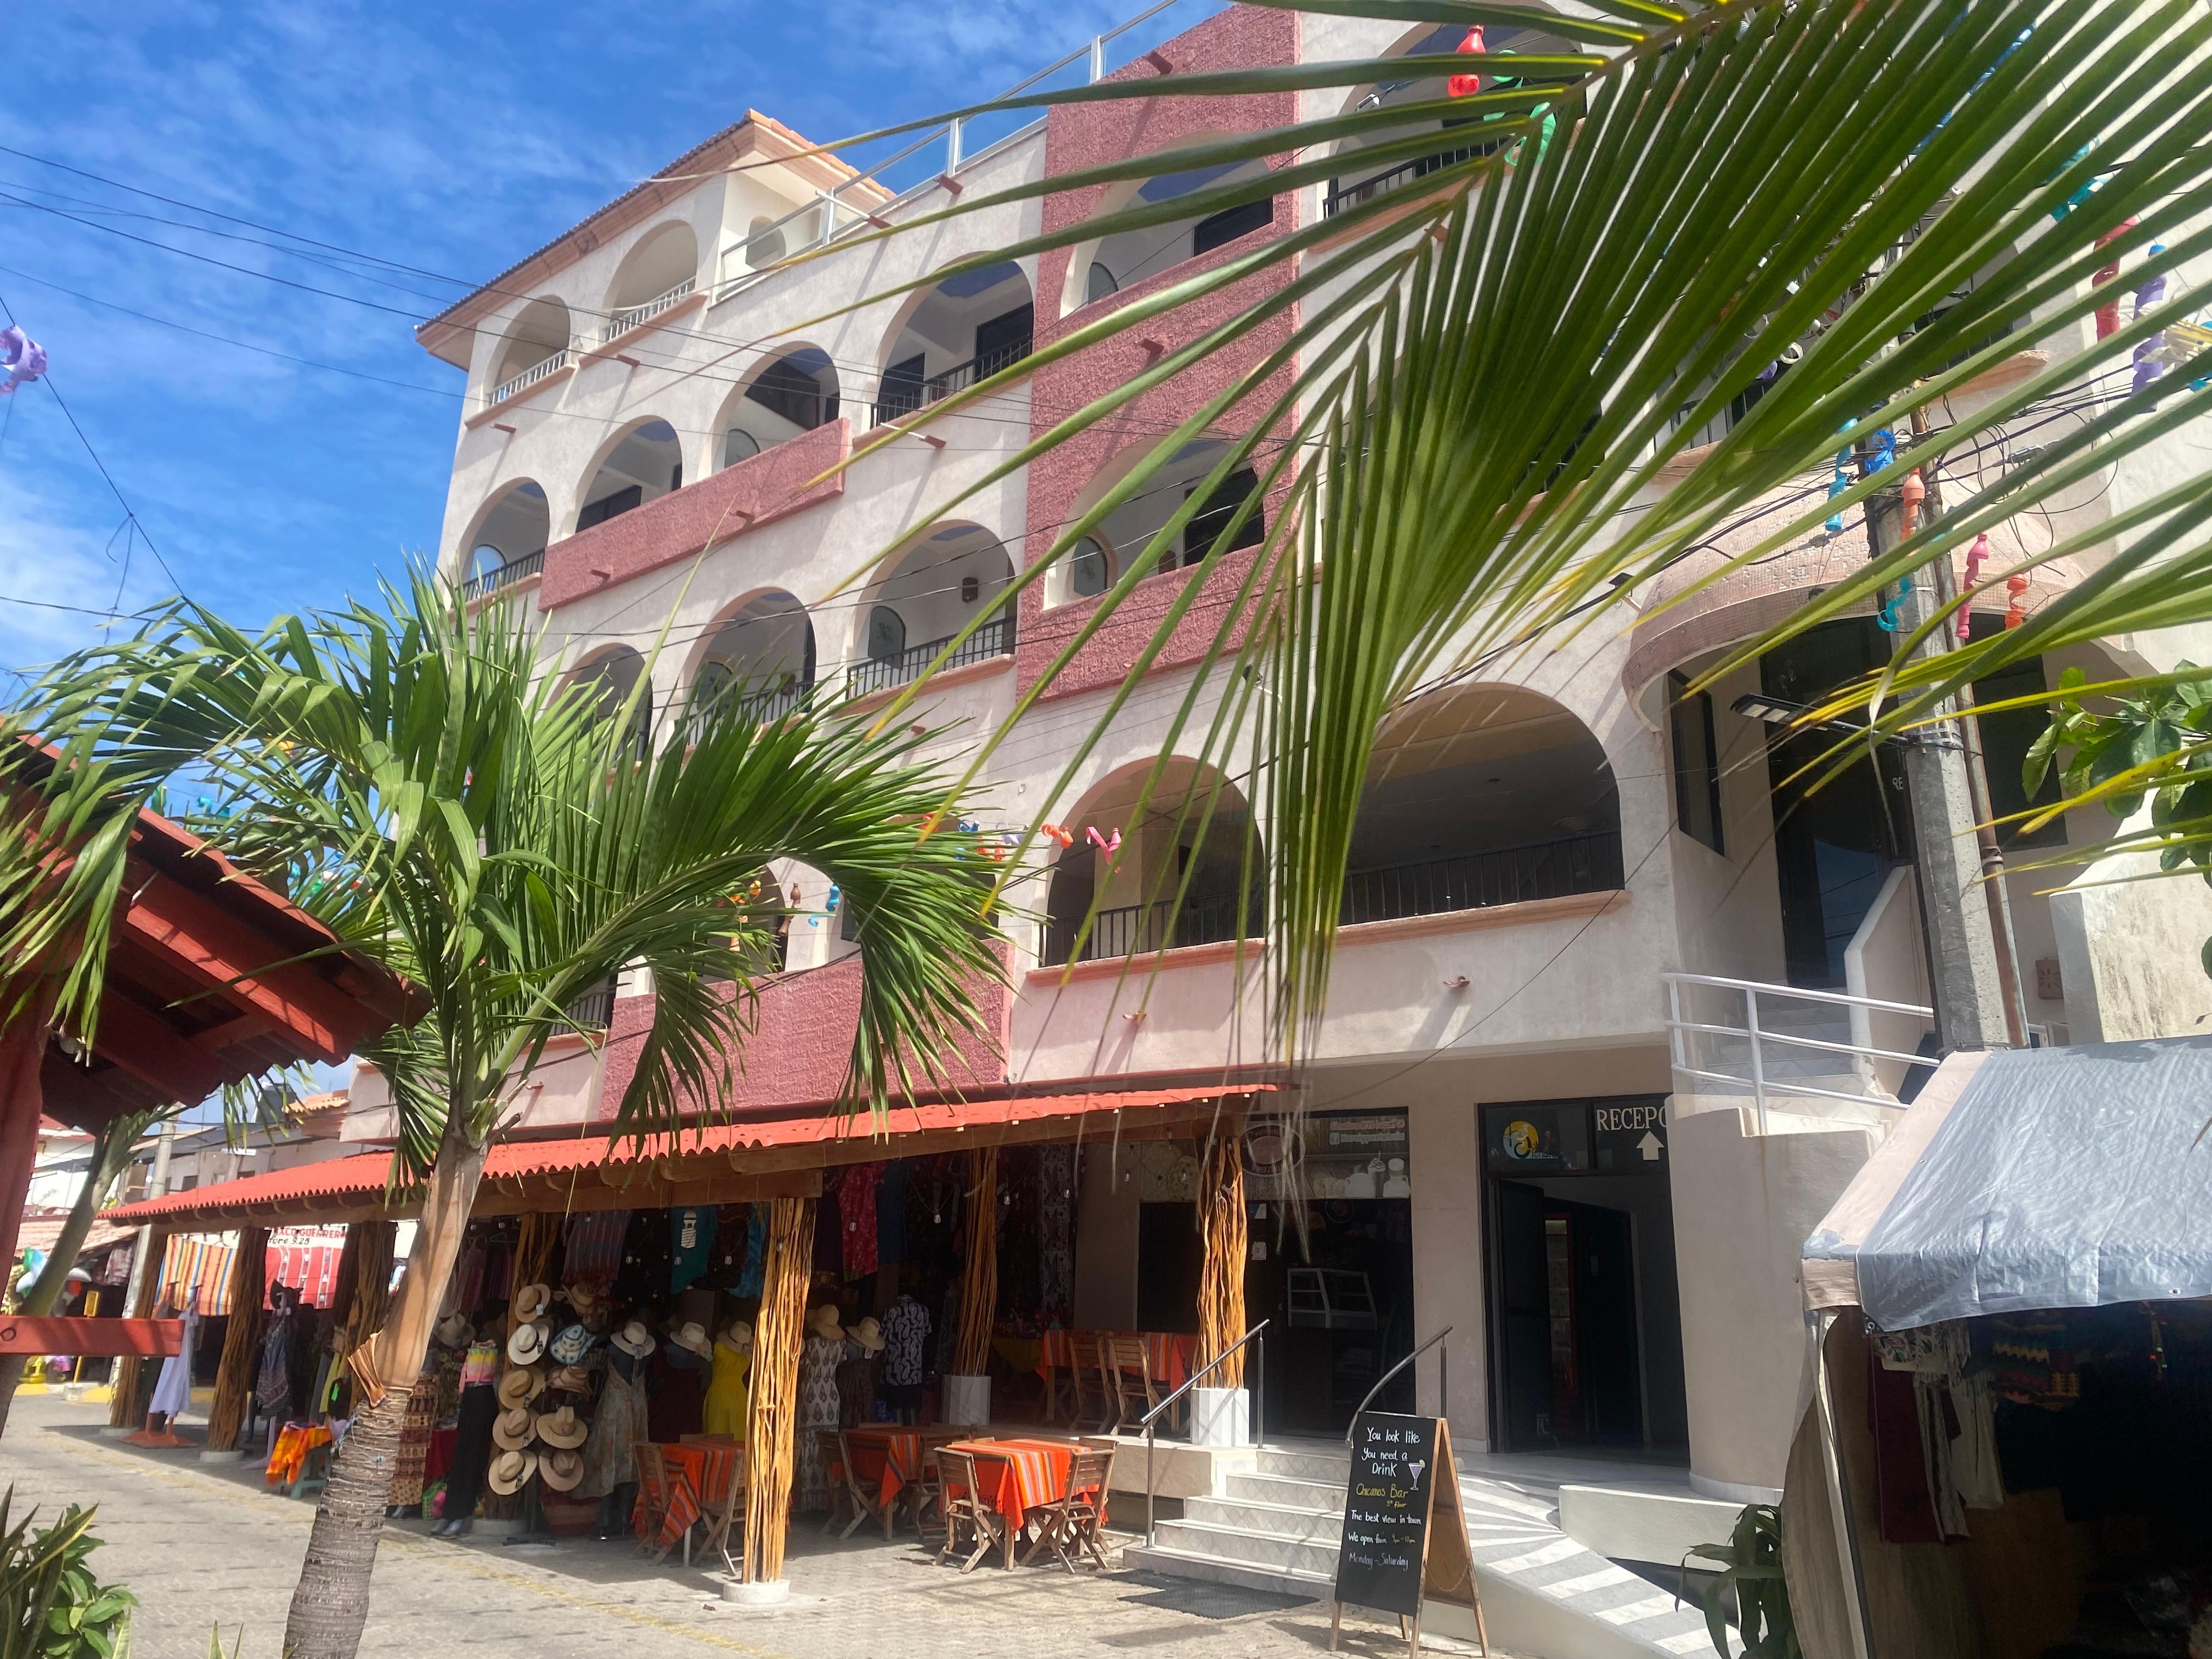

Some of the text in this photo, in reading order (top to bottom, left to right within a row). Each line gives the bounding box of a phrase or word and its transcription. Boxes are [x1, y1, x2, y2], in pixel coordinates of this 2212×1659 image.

[1367, 1426, 1420, 1444] You look like
[1380, 1449, 1398, 1460] need
[1401, 1452, 1408, 1461] a
[1356, 1483, 1409, 1498] Chicanos Bar
[1351, 1509, 1422, 1525] The best view in town
[1348, 1531, 1359, 1542] We
[1360, 1536, 1374, 1546] open
[1375, 1533, 1387, 1544] from
